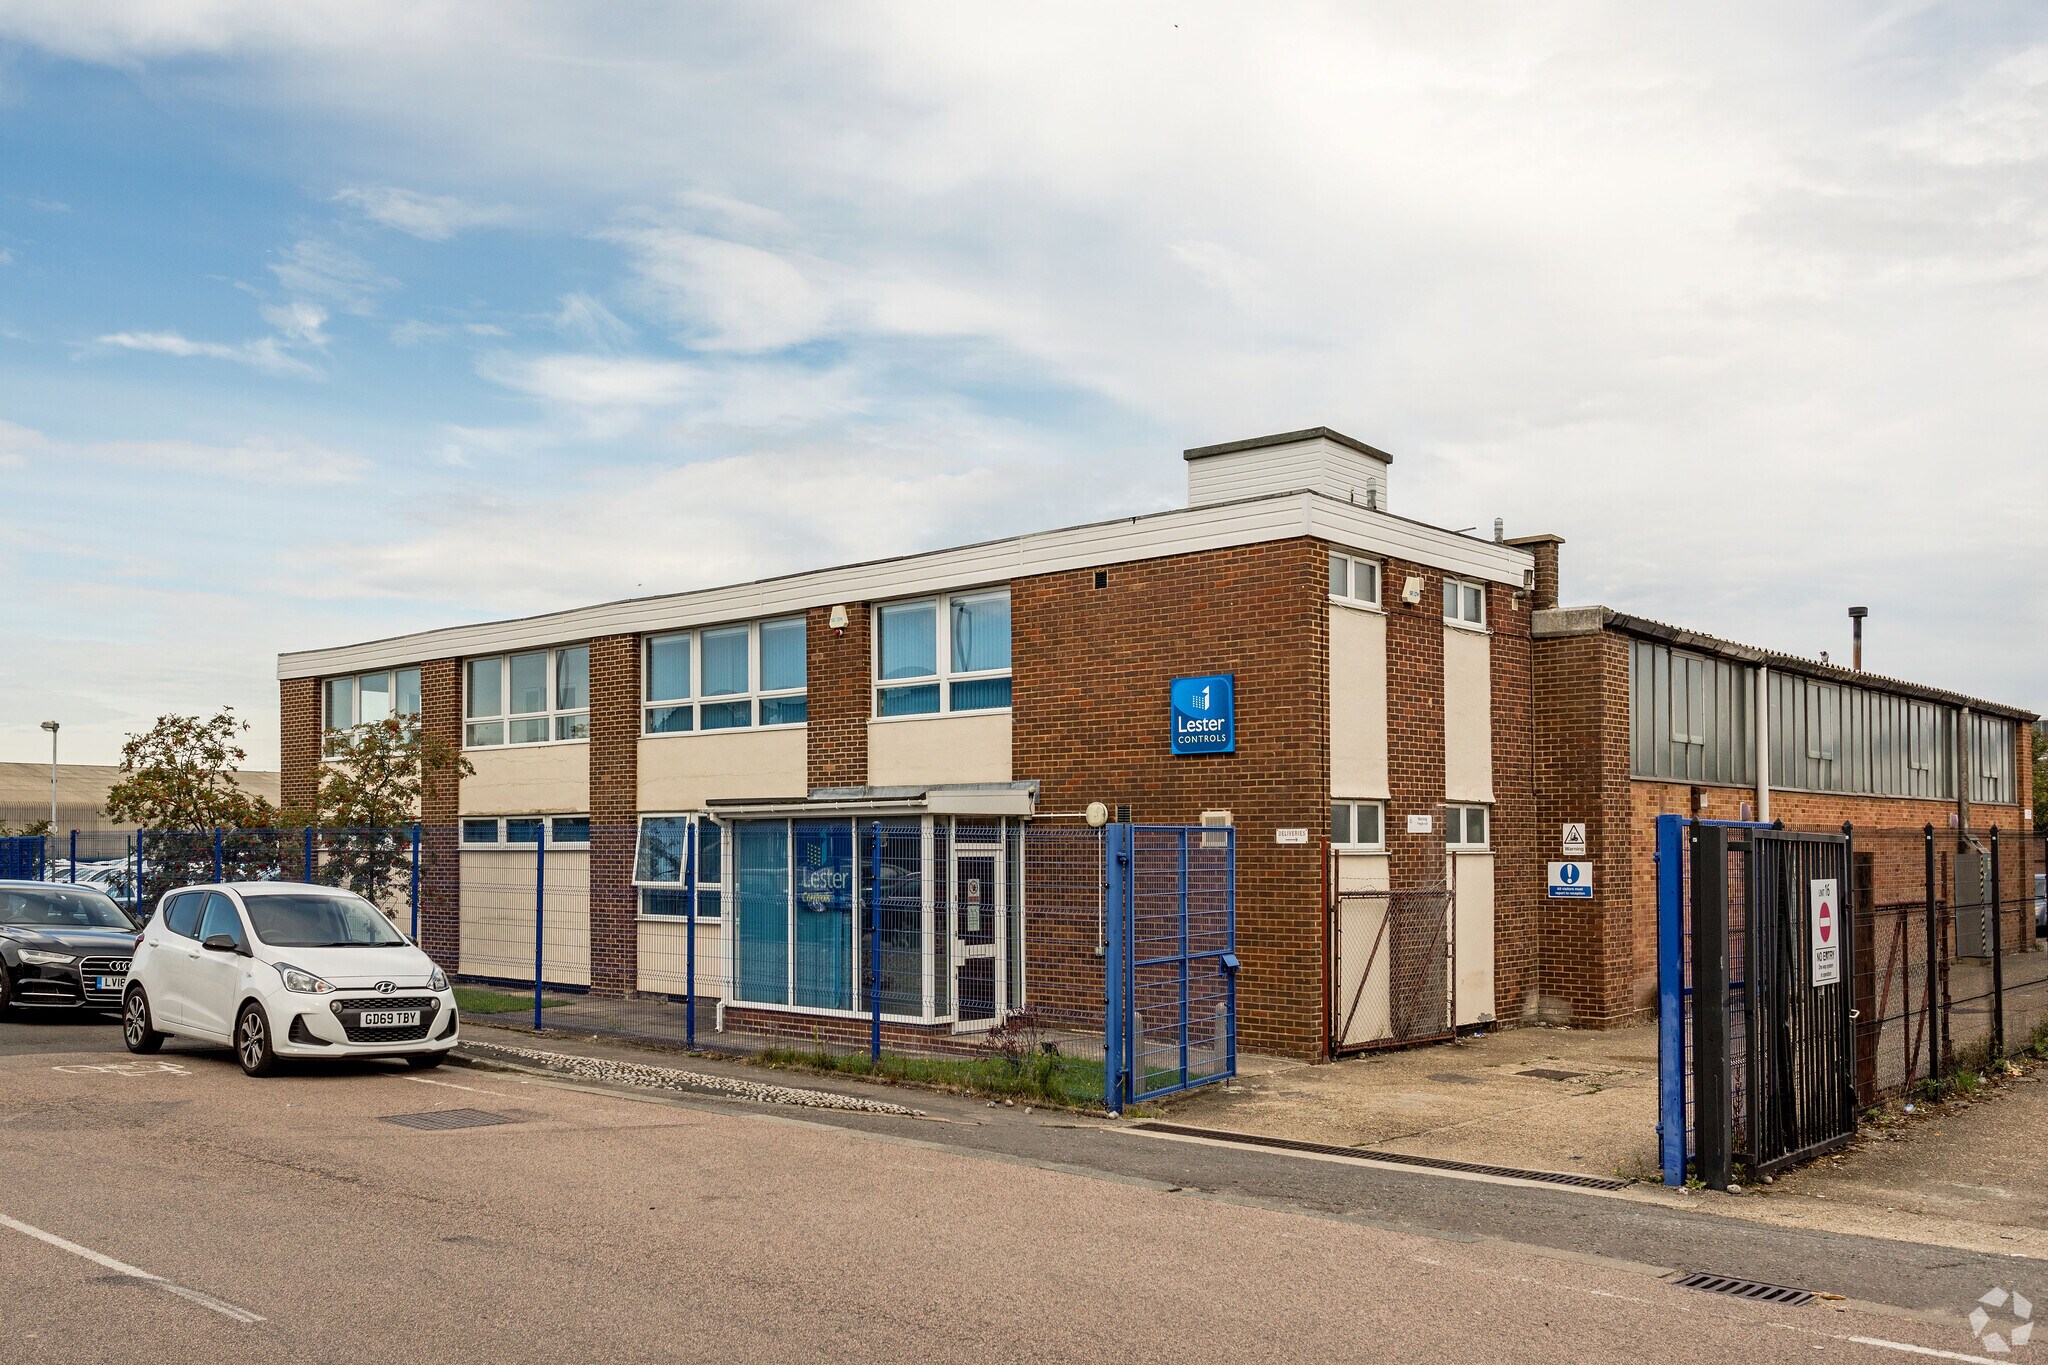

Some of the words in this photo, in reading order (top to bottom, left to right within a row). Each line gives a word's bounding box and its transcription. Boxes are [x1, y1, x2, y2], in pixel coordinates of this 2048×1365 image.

[1178, 716, 1225, 733] Lester
[1178, 734, 1226, 744] CONTROLS
[802, 866, 849, 889] Lester
[365, 1013, 394, 1025] GD69
[396, 1012, 416, 1024] TBY
